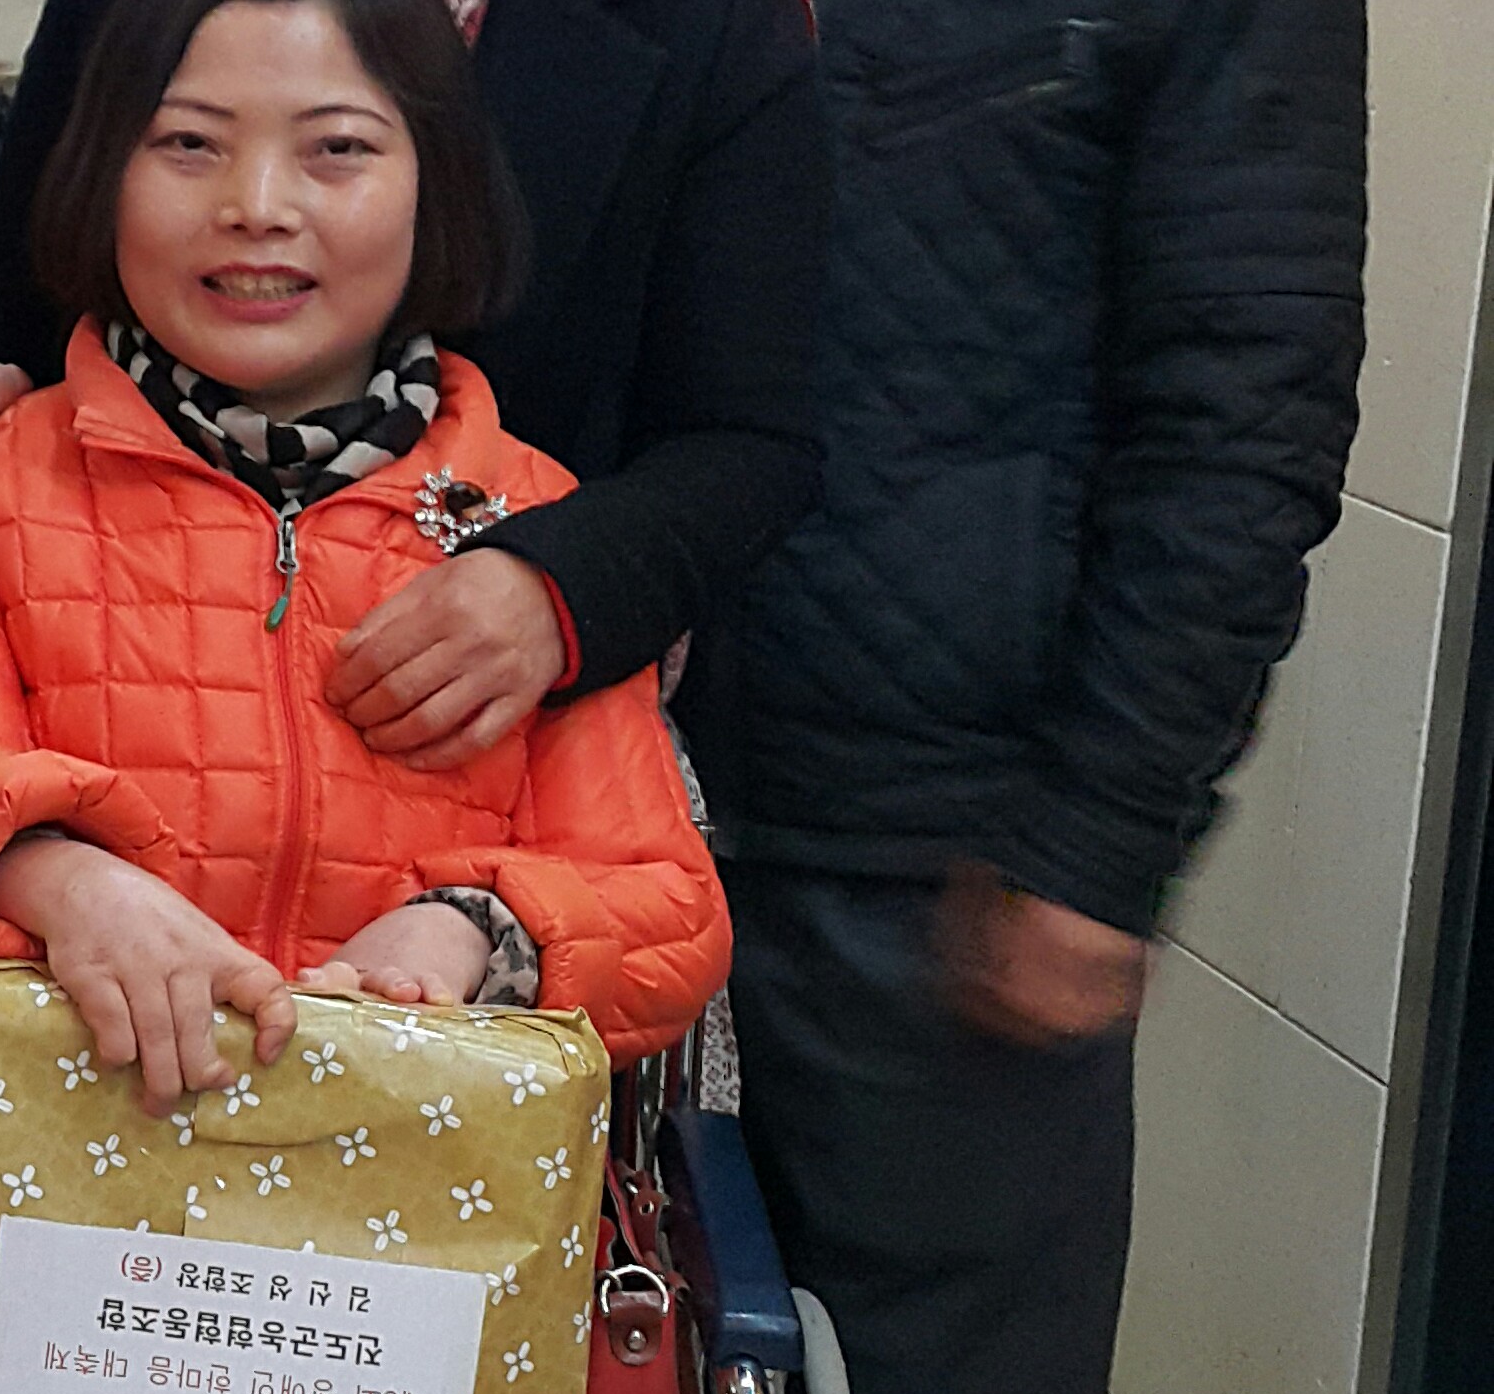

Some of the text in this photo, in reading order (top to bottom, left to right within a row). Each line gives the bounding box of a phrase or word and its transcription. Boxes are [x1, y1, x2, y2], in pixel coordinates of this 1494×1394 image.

[120, 1251, 372, 1313] 김 신 성 조합장 (증)
[96, 1297, 384, 1367] 진도군농협협동조합
[44, 1340, 128, 1378] 대축제
[146, 1354, 232, 1394] 한마음
